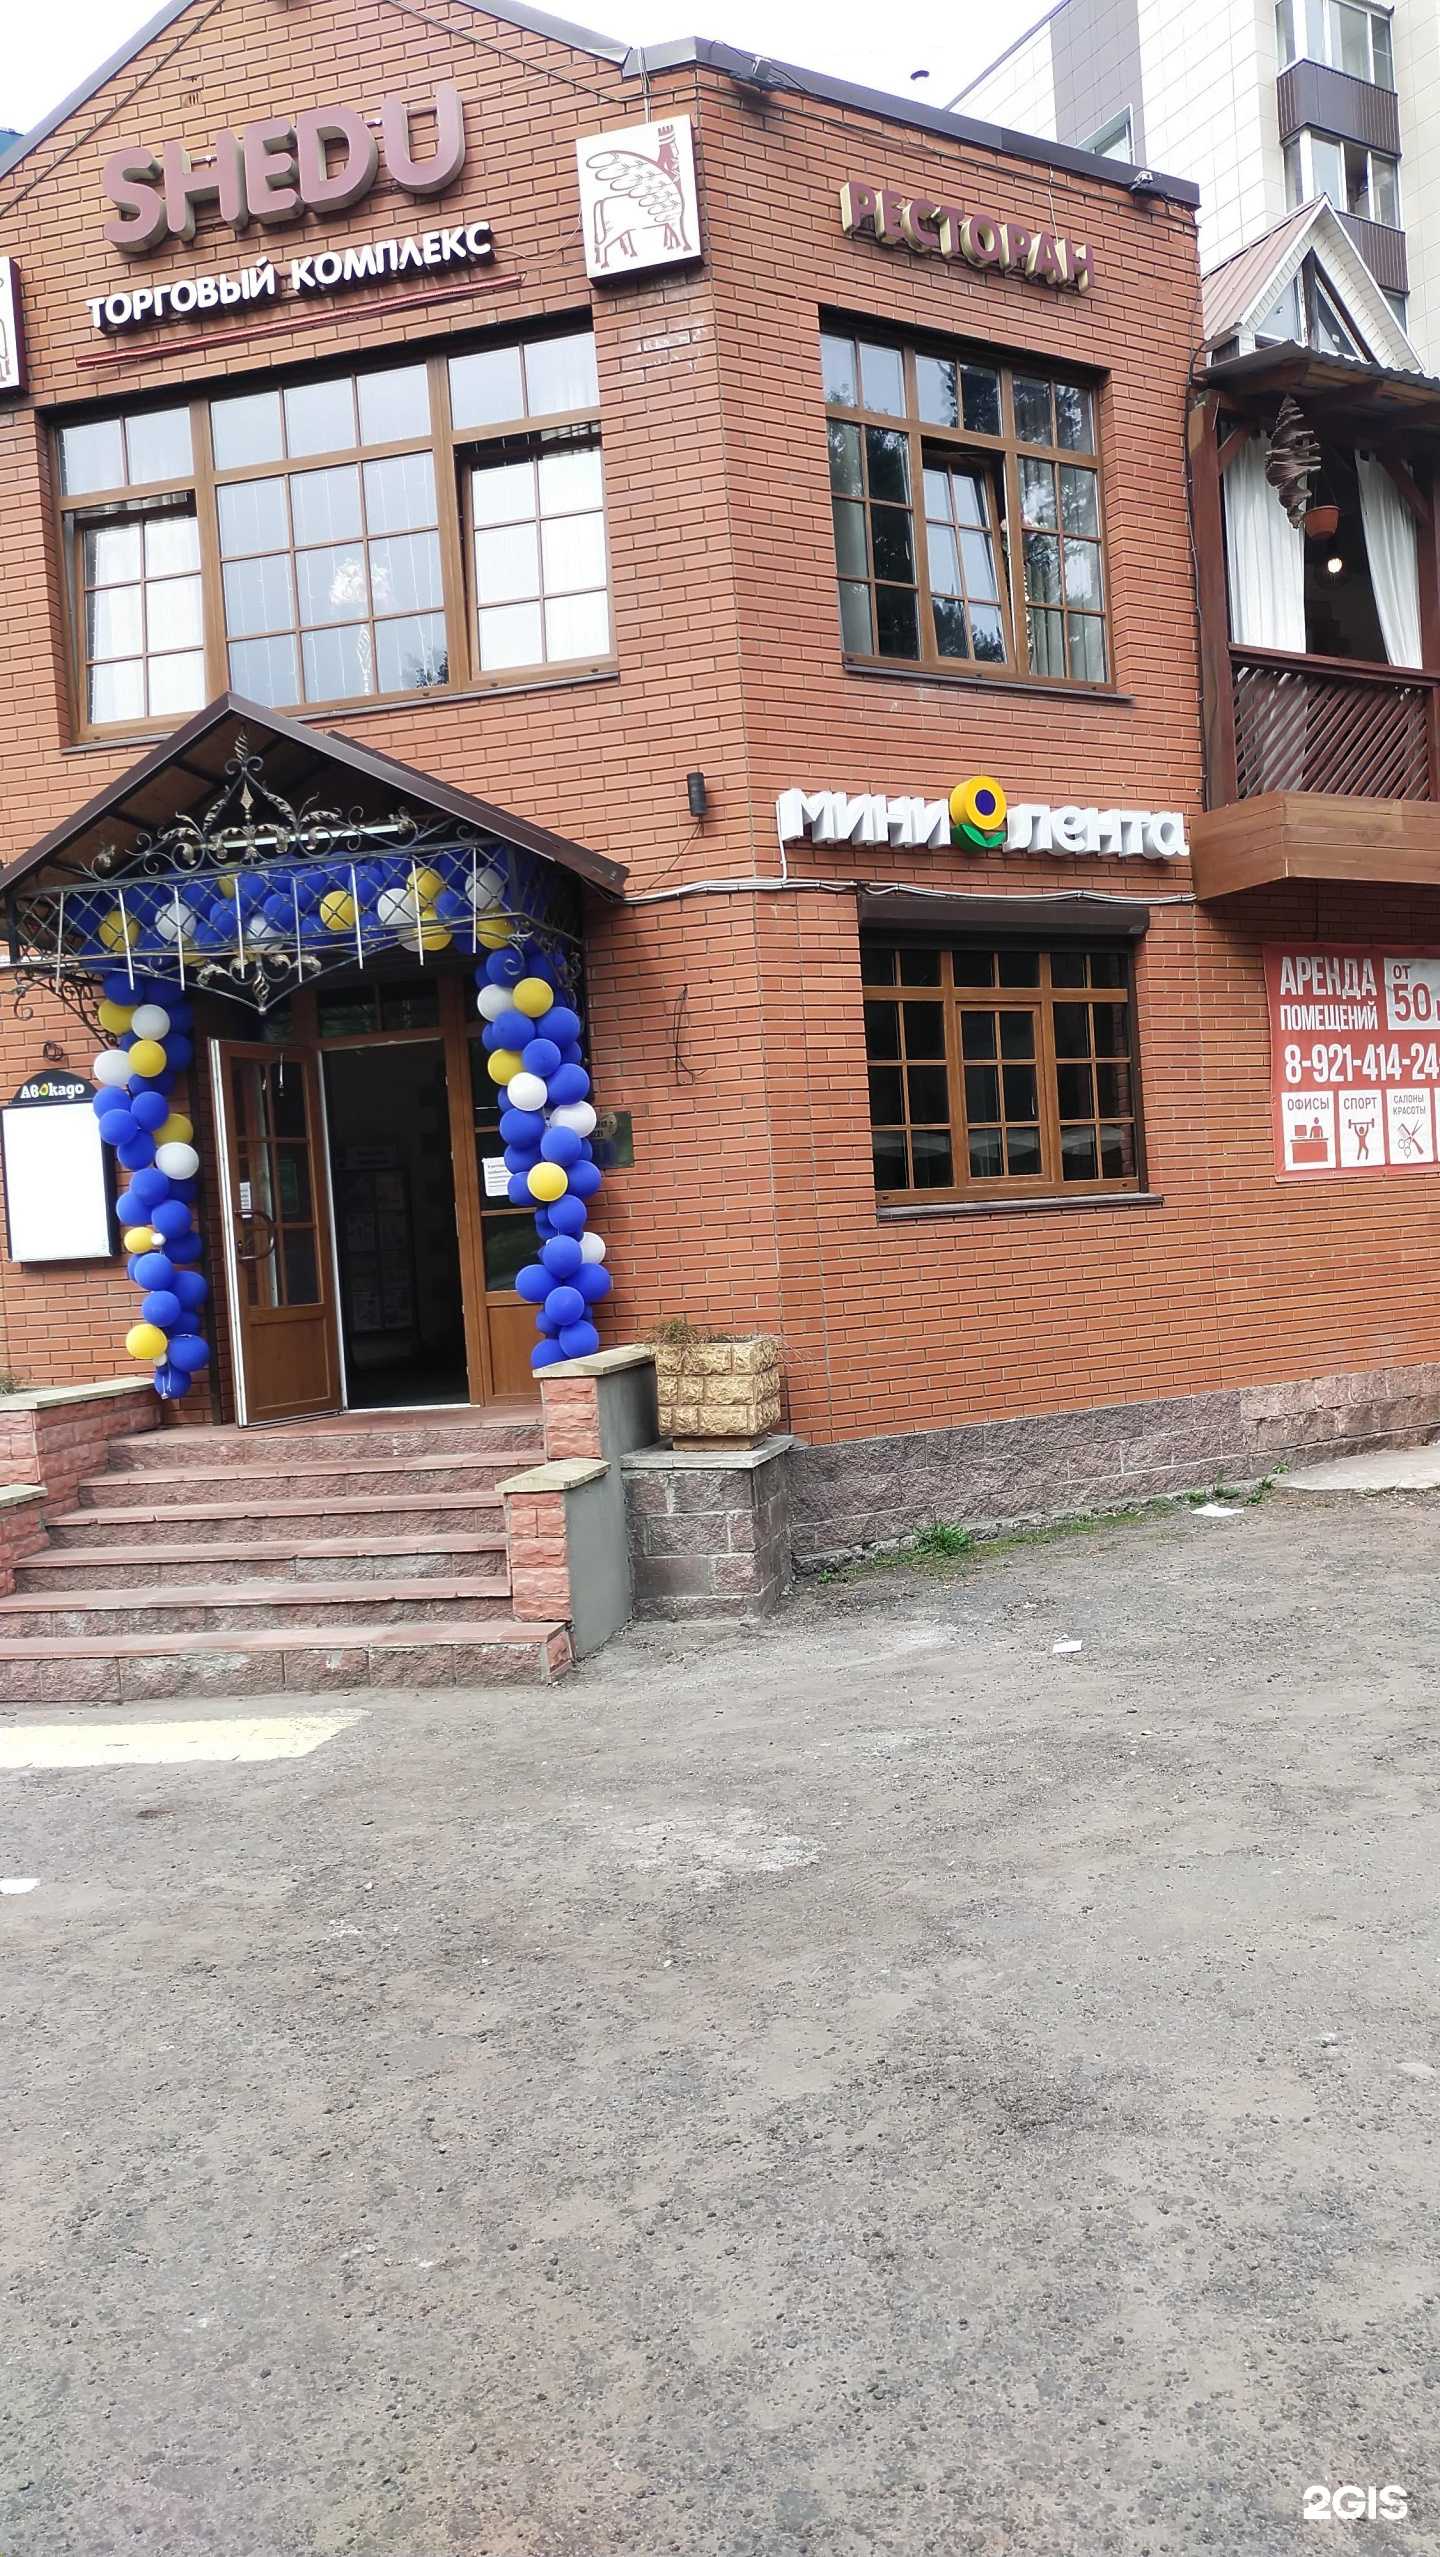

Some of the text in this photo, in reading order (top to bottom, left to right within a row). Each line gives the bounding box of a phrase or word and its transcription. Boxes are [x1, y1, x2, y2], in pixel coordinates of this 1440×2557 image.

[102, 82, 465, 252] SHEDU
[840, 181, 1094, 295] РЕСТОРАН
[87, 221, 492, 328] ТОРГОВЫЙ КОМПЛЕКС
[1280, 956, 1378, 1000] АРЕНДА
[1280, 1001, 1379, 1032] ПОМЕЩЕНИЙ
[1392, 982, 1433, 1022] 50
[1284, 1042, 1440, 1084] 8-921-414-24
[1287, 1096, 1330, 1111] ОФИСЫ
[1343, 1096, 1377, 1110] СПОРТ
[1392, 1105, 1426, 1115] КРАСОТЫ
[1393, 1094, 1425, 1104] САЛОНЫ
